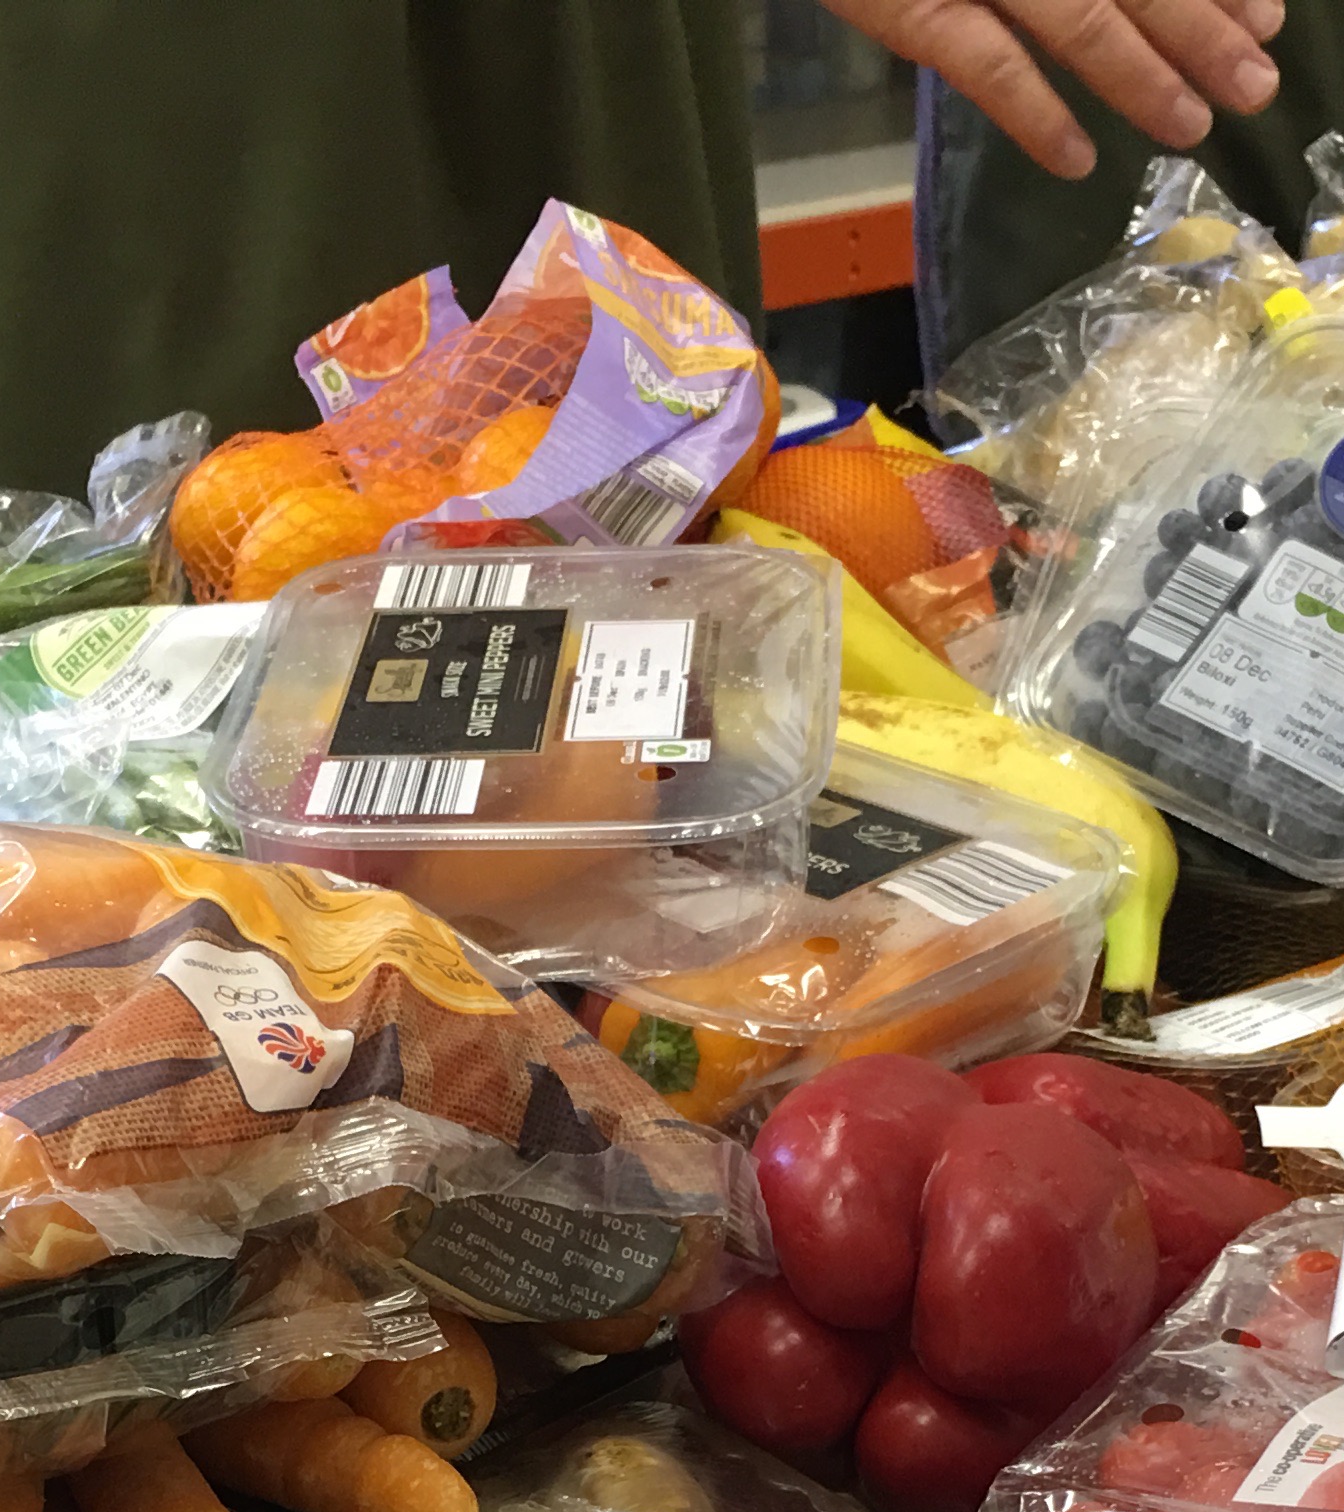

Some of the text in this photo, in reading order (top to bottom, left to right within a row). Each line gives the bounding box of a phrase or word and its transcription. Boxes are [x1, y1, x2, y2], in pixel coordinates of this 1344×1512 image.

[54, 624, 114, 683] GREEN
[1207, 641, 1235, 665] 08
[1233, 653, 1274, 684] Dec
[465, 623, 516, 736] SWEET MINI PEPPERS
[1195, 660, 1237, 689] Biloxi
[220, 964, 257, 975] OFFICIAL
[222, 1004, 305, 1020] TEAM GB
[601, 1212, 649, 1242] work
[518, 1225, 627, 1287] and growers
[619, 1244, 659, 1270] our
[480, 1260, 512, 1284] every
[513, 1276, 544, 1300] day,
[517, 1259, 567, 1290] fresh,
[567, 1280, 617, 1312] quality
[1255, 1422, 1323, 1491] The co-operative
